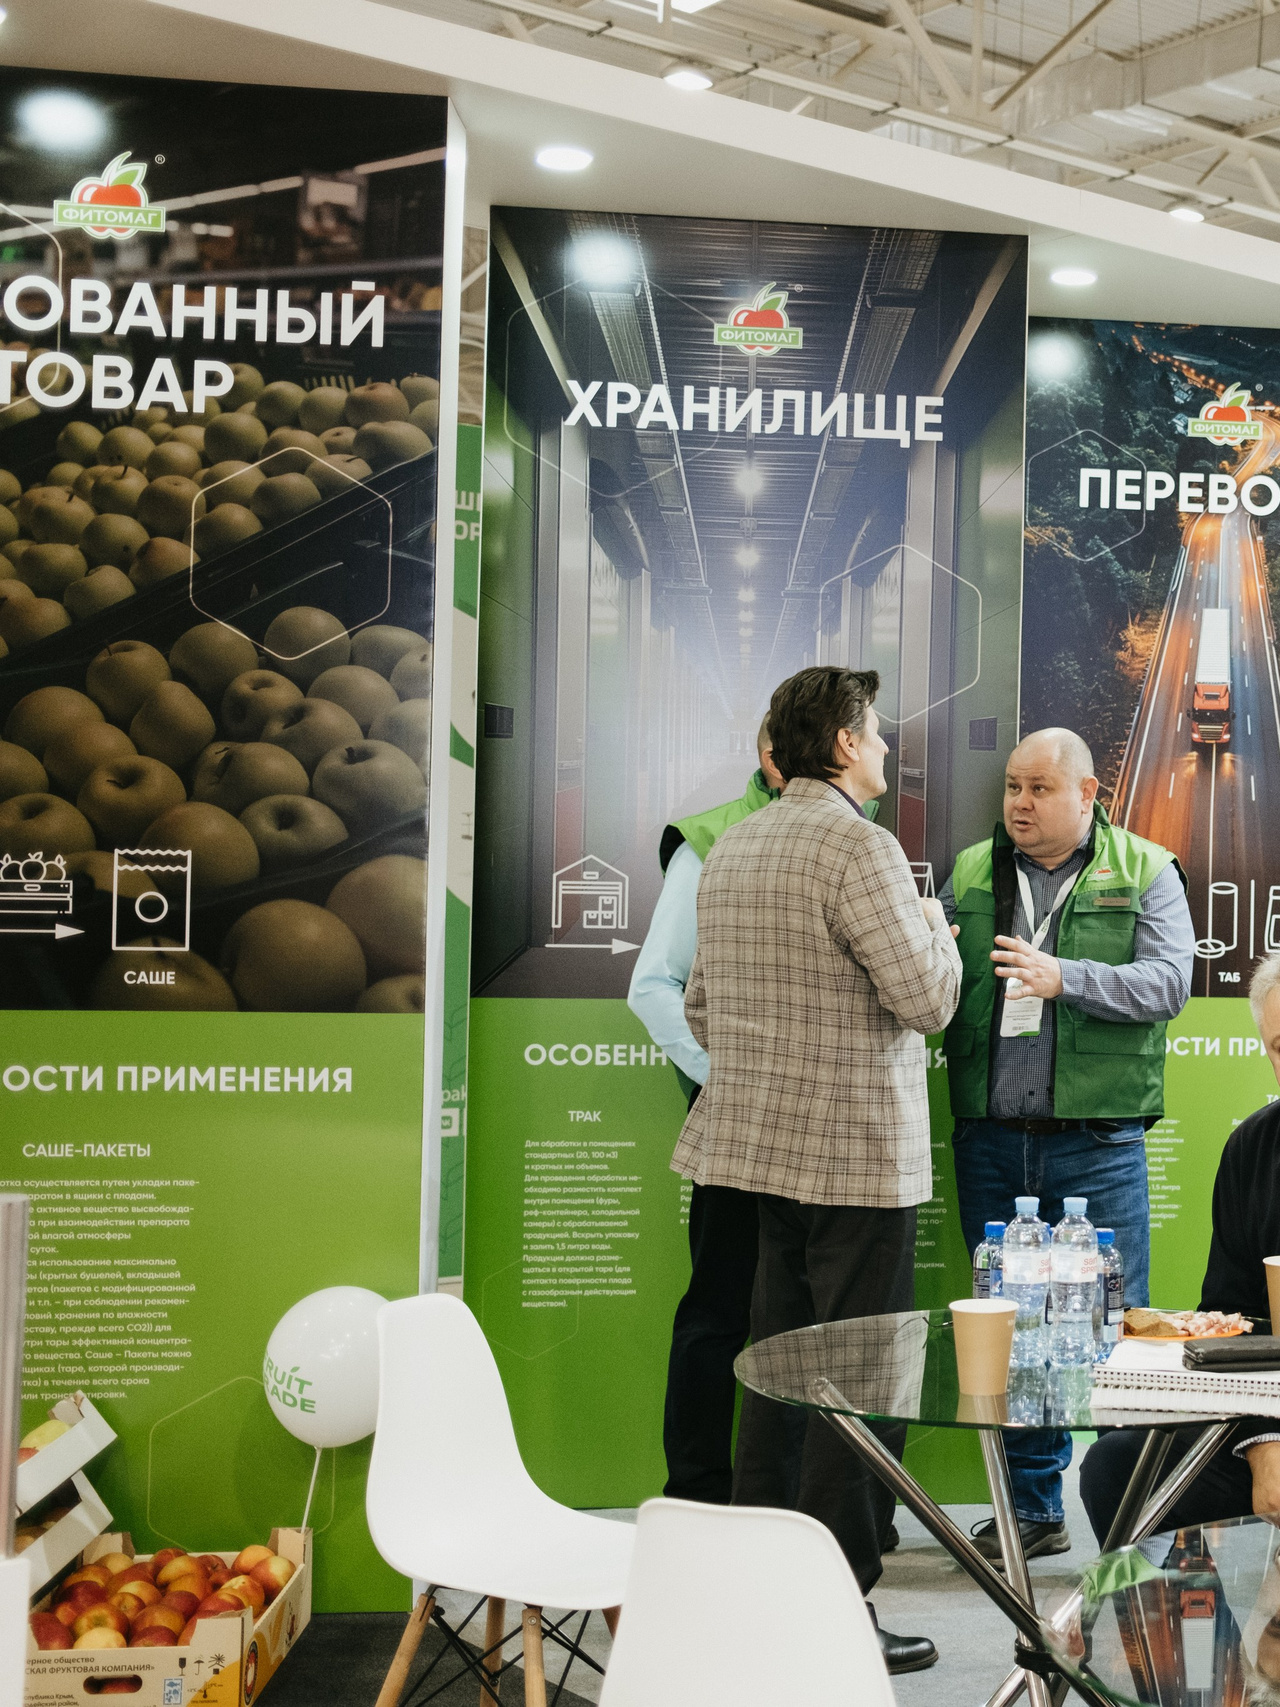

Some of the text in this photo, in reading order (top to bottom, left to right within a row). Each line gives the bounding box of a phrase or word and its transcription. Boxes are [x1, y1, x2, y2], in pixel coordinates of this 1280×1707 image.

[62, 207, 158, 225] ФИТОМАГ
[720, 328, 797, 344] ФИТОМАГ
[0, 350, 235, 414] ТОВАР
[563, 379, 944, 448] ХРАНИЛИЩЕ
[1192, 423, 1260, 436] ФИТОМАГ
[123, 970, 176, 985] САШЕ
[1218, 972, 1241, 983] ТАБ
[117, 1066, 352, 1093] ПРИМЕНЕНИЯ
[568, 1110, 601, 1122] ТРАК
[22, 1143, 151, 1157] САШЕ-ПАКЕТЫ
[263, 1374, 316, 1413] RADE
[49, 1666, 99, 1674] ФРУКТОВАЯ
[102, 1664, 155, 1673] КОМПАНИЯ»
